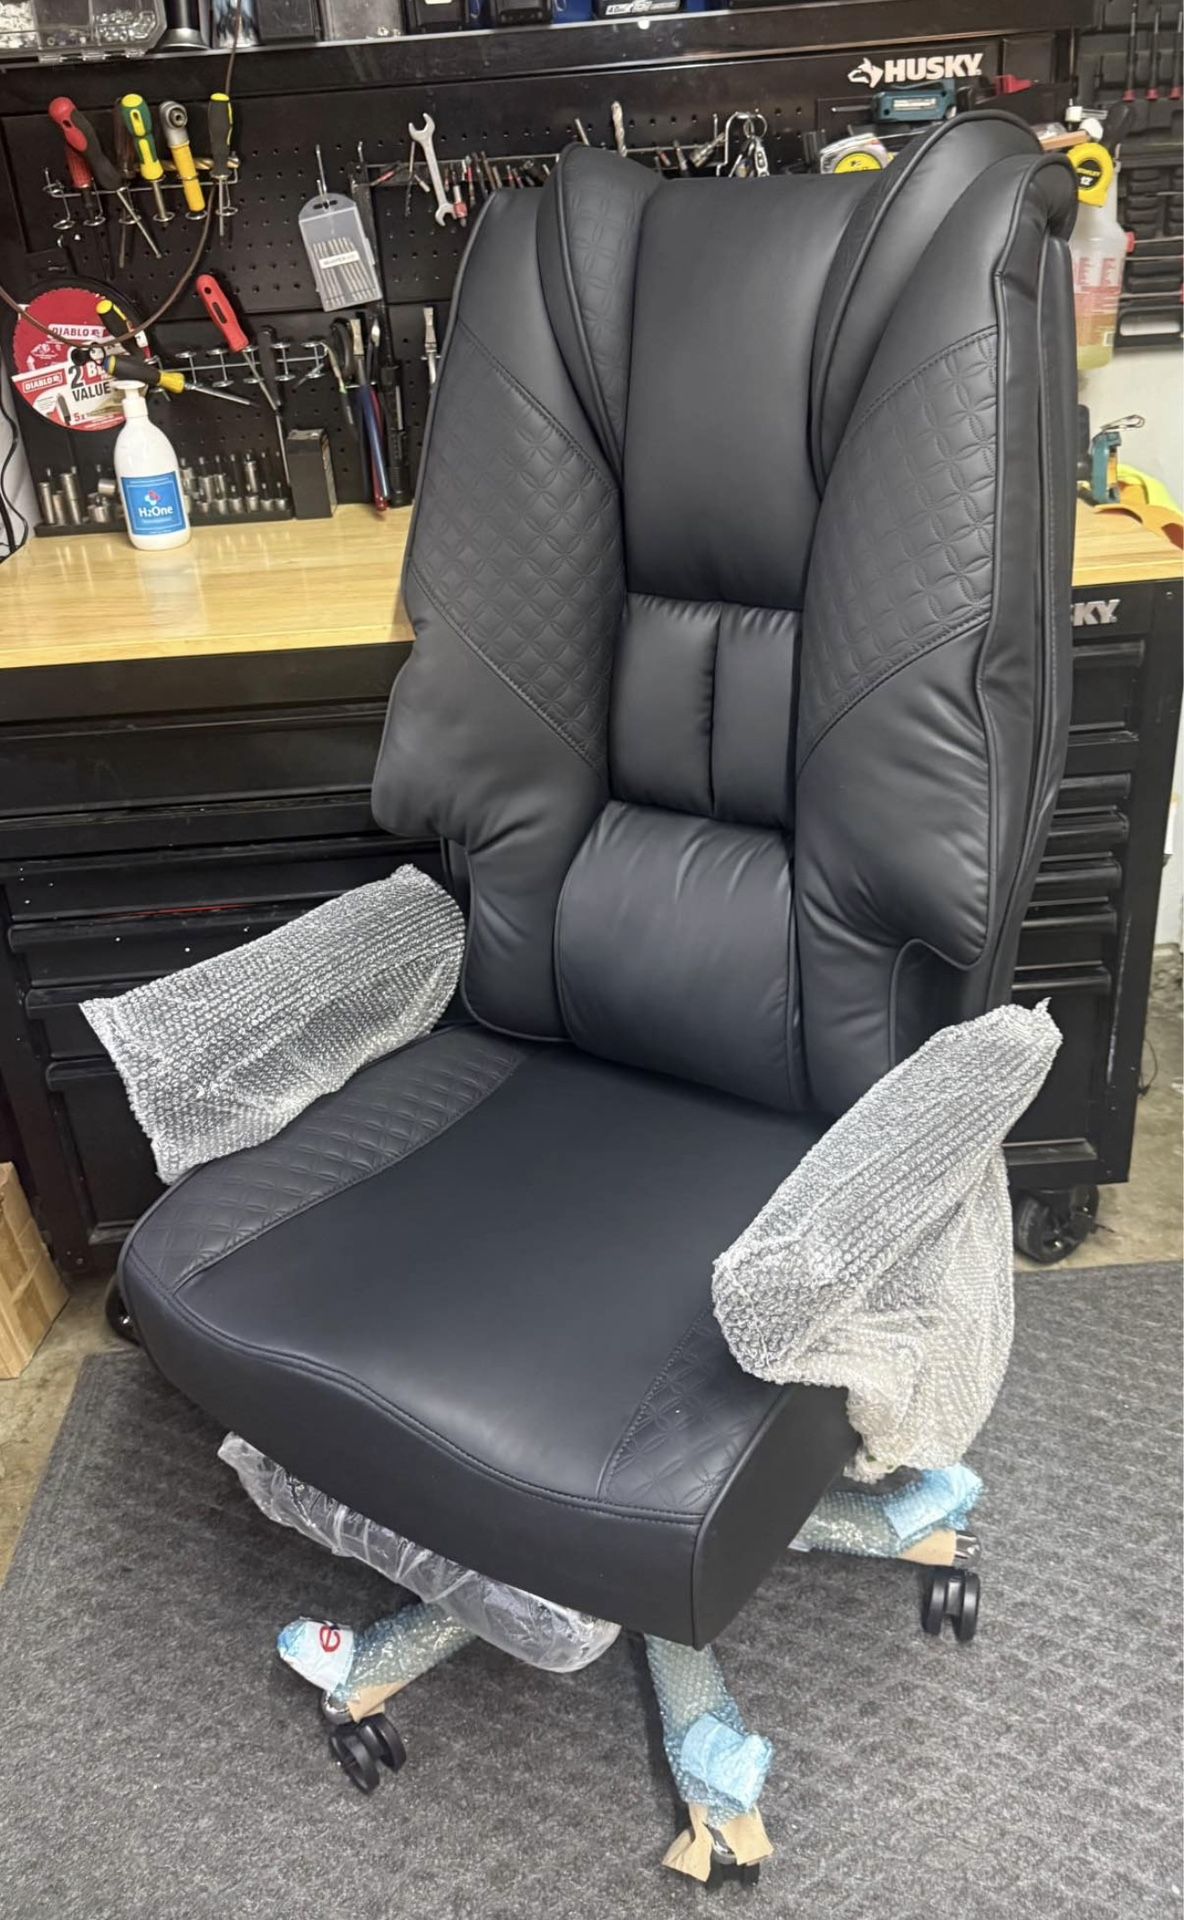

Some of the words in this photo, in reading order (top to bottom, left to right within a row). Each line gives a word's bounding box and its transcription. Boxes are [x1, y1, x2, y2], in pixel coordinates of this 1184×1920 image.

[884, 53, 983, 83] HUSKY
[52, 326, 90, 338] DIABLO
[24, 376, 53, 391] DIABLO
[68, 366, 84, 390] 2
[72, 382, 112, 402] VALUE
